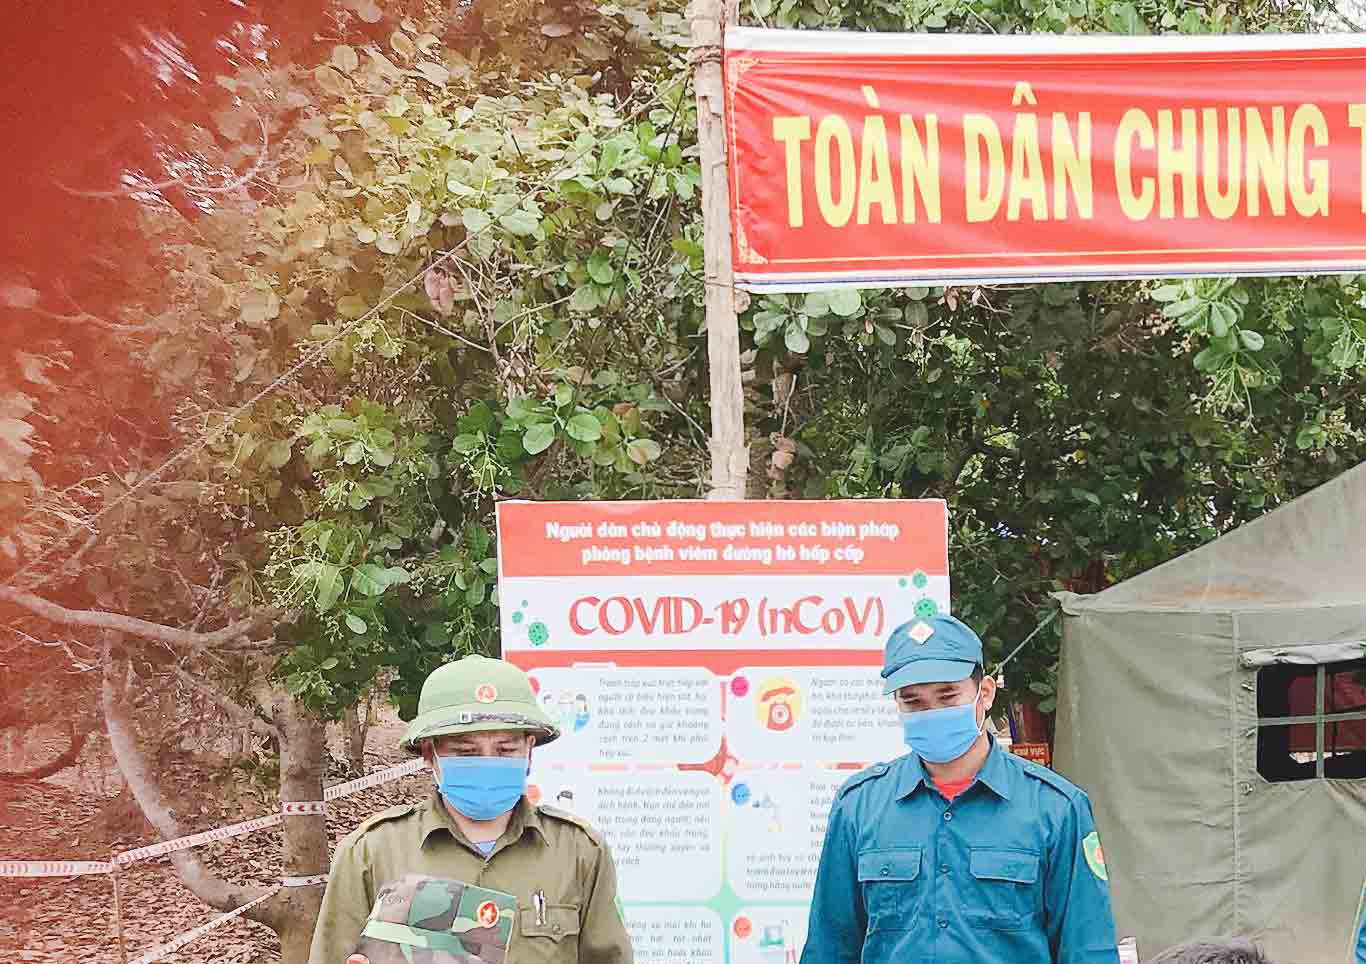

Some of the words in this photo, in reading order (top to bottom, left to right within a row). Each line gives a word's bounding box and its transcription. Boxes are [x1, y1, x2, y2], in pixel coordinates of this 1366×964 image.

[773, 85, 942, 228] TOÀN
[963, 81, 1094, 223] DÂN
[1114, 103, 1330, 221] CHUNG
[545, 522, 592, 542] Người
[666, 522, 706, 541] động
[749, 521, 785, 540] hiện
[820, 521, 855, 540] biện
[859, 521, 899, 541] pháp
[581, 545, 631, 566] phòng
[634, 544, 674, 563] bệnh
[678, 545, 718, 561] viêm
[569, 595, 749, 637] COVID-19
[757, 594, 885, 637] (nCoV)
